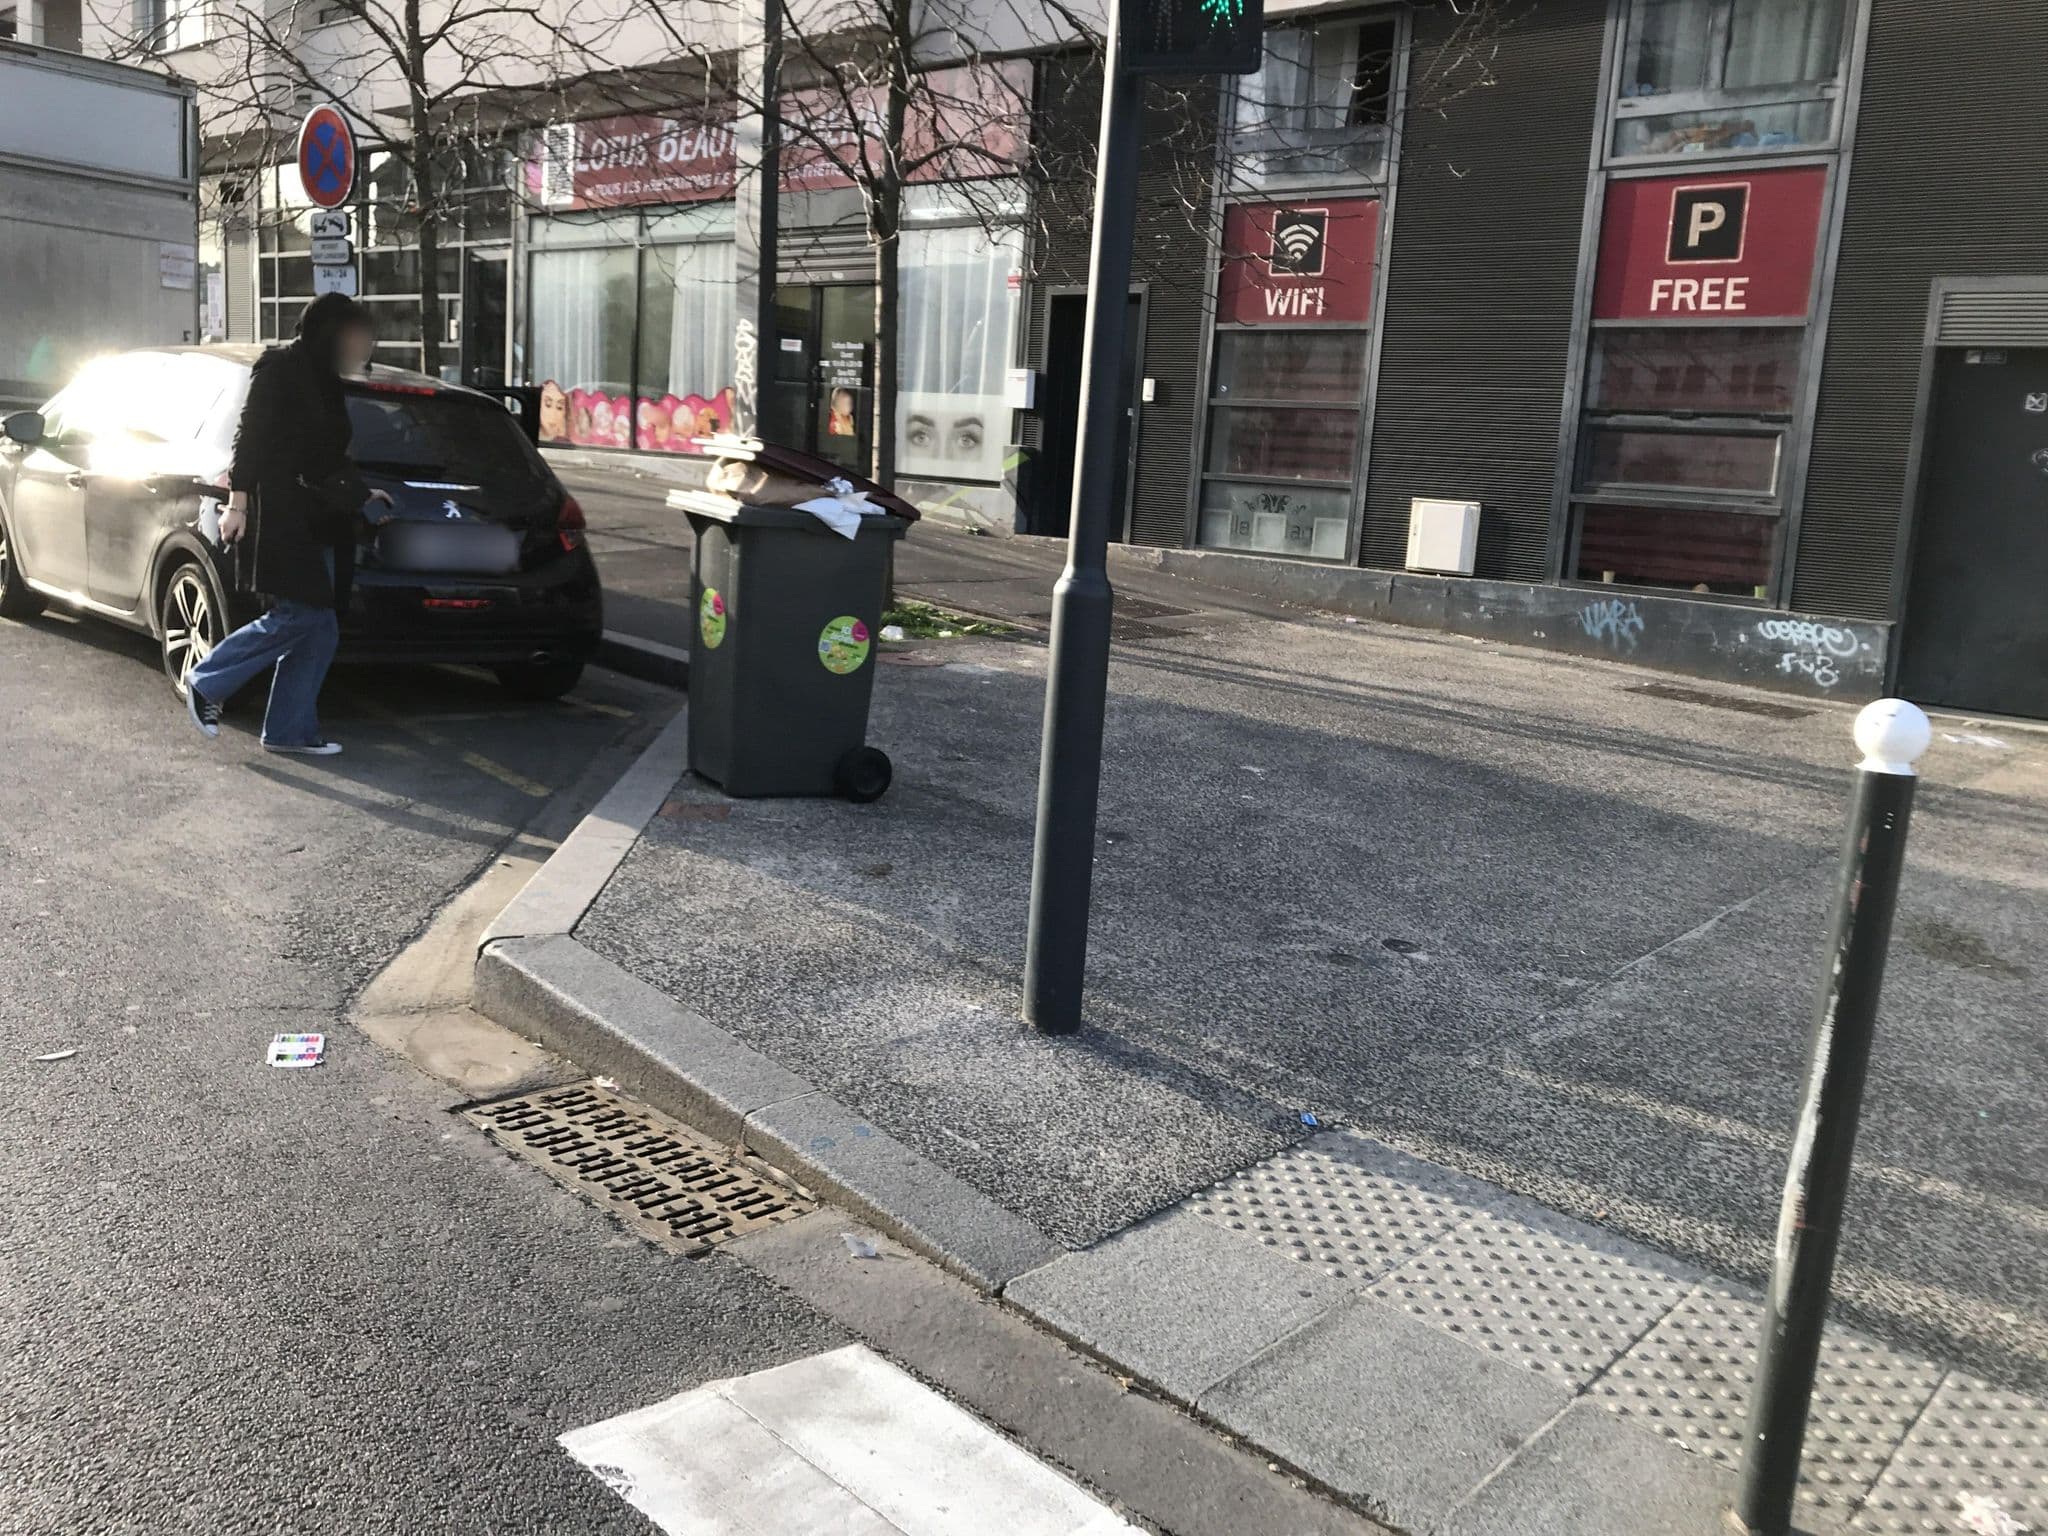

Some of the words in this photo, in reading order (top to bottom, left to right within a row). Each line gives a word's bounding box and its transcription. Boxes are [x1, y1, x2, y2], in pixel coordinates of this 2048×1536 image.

[574, 131, 649, 172] LOTUS
[1687, 202, 1726, 247] P
[1264, 287, 1325, 316] WIFI
[1650, 277, 1750, 311] FREE
